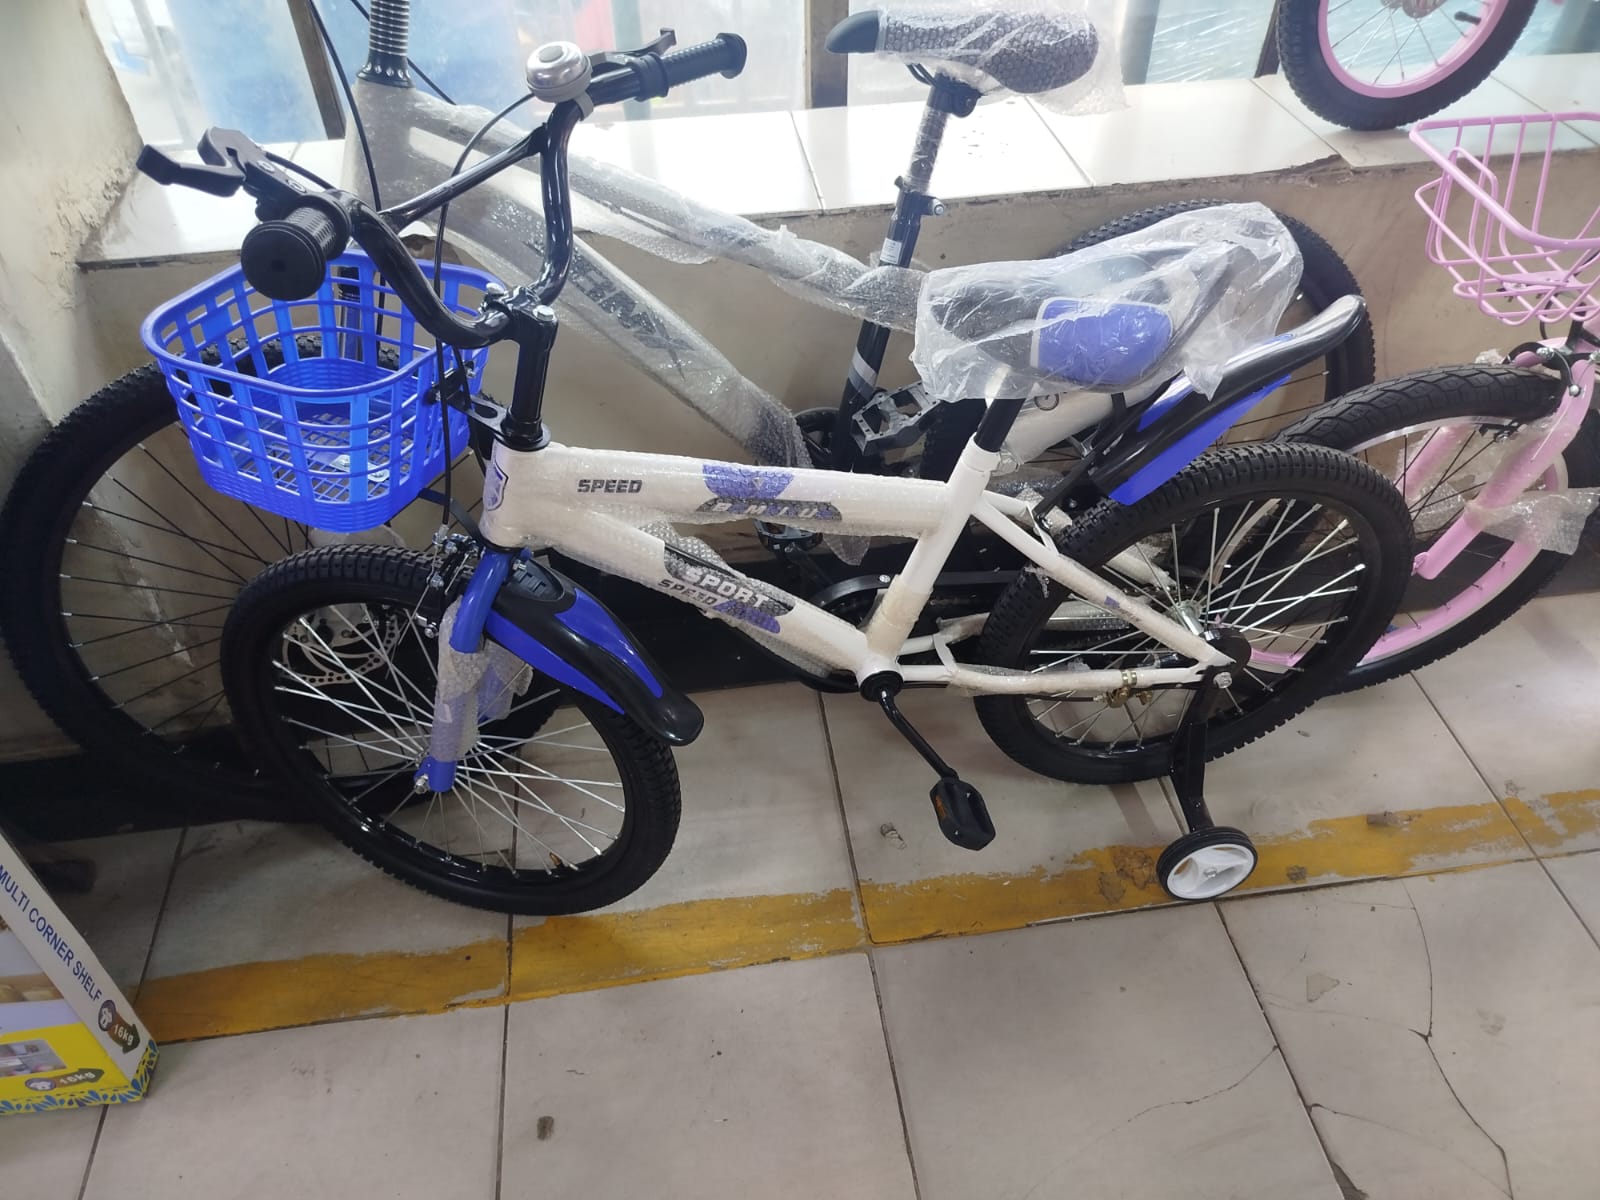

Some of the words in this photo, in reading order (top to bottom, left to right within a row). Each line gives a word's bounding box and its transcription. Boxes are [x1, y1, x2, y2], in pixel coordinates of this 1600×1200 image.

[577, 479, 643, 493] SPEED
[657, 579, 718, 605] SPEED
[681, 566, 770, 607] SPORT
[0, 864, 30, 912] MULTI
[28, 907, 74, 967] CORNER
[72, 960, 103, 1002] SHELF
[114, 1024, 134, 1046] 16kg
[59, 1071, 96, 1085] 16kg
